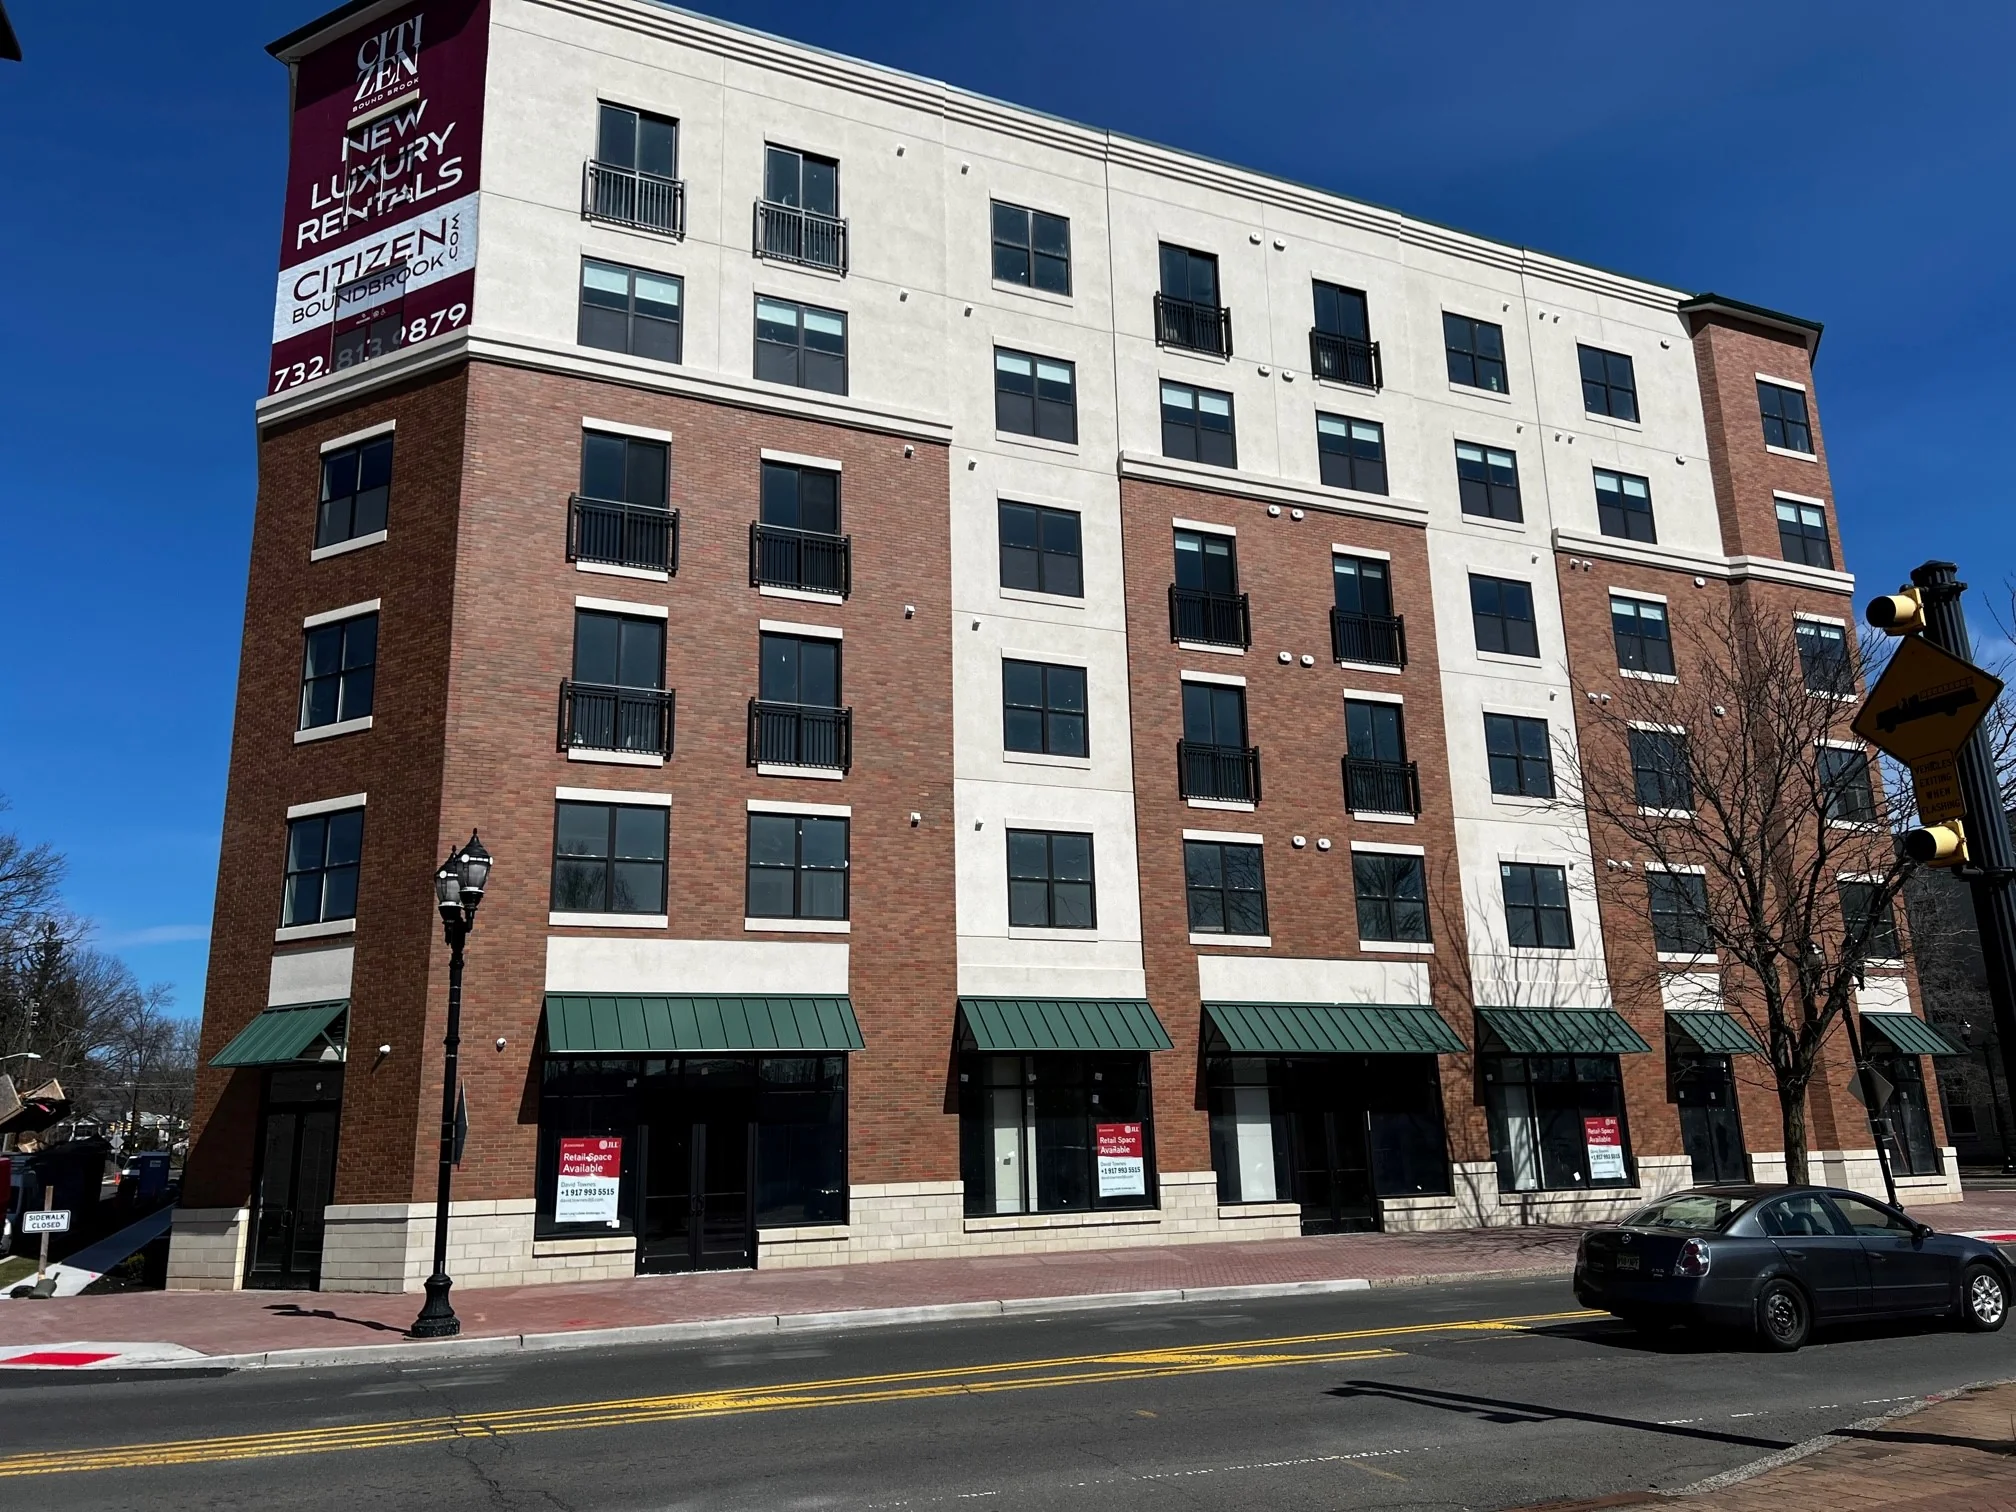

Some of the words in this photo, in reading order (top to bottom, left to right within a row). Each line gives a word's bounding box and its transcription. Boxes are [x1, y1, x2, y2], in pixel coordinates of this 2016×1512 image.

[357, 13, 424, 71] CITI
[354, 44, 419, 102] ZEN
[352, 94, 384, 113] BOUND
[387, 77, 419, 97] BROOK
[341, 99, 428, 162] NEW
[311, 122, 456, 210] LUXURY
[296, 156, 463, 250] RENTALS
[293, 218, 447, 301] CITIZEN
[292, 253, 444, 324] BOUNDBROOK
[1914, 758, 1953, 775] VEHICLES
[1919, 772, 1952, 788] EXITING
[1925, 787, 1951, 799] WHEN
[1921, 799, 1961, 815] FLASHING
[1118, 1136, 1136, 1144] Space
[563, 1153, 586, 1161] Retail
[589, 1153, 612, 1162] Space
[1100, 1146, 1130, 1154] Available
[563, 1164, 603, 1173] Available
[584, 1188, 596, 1196] 993
[598, 1188, 614, 1196] 5515
